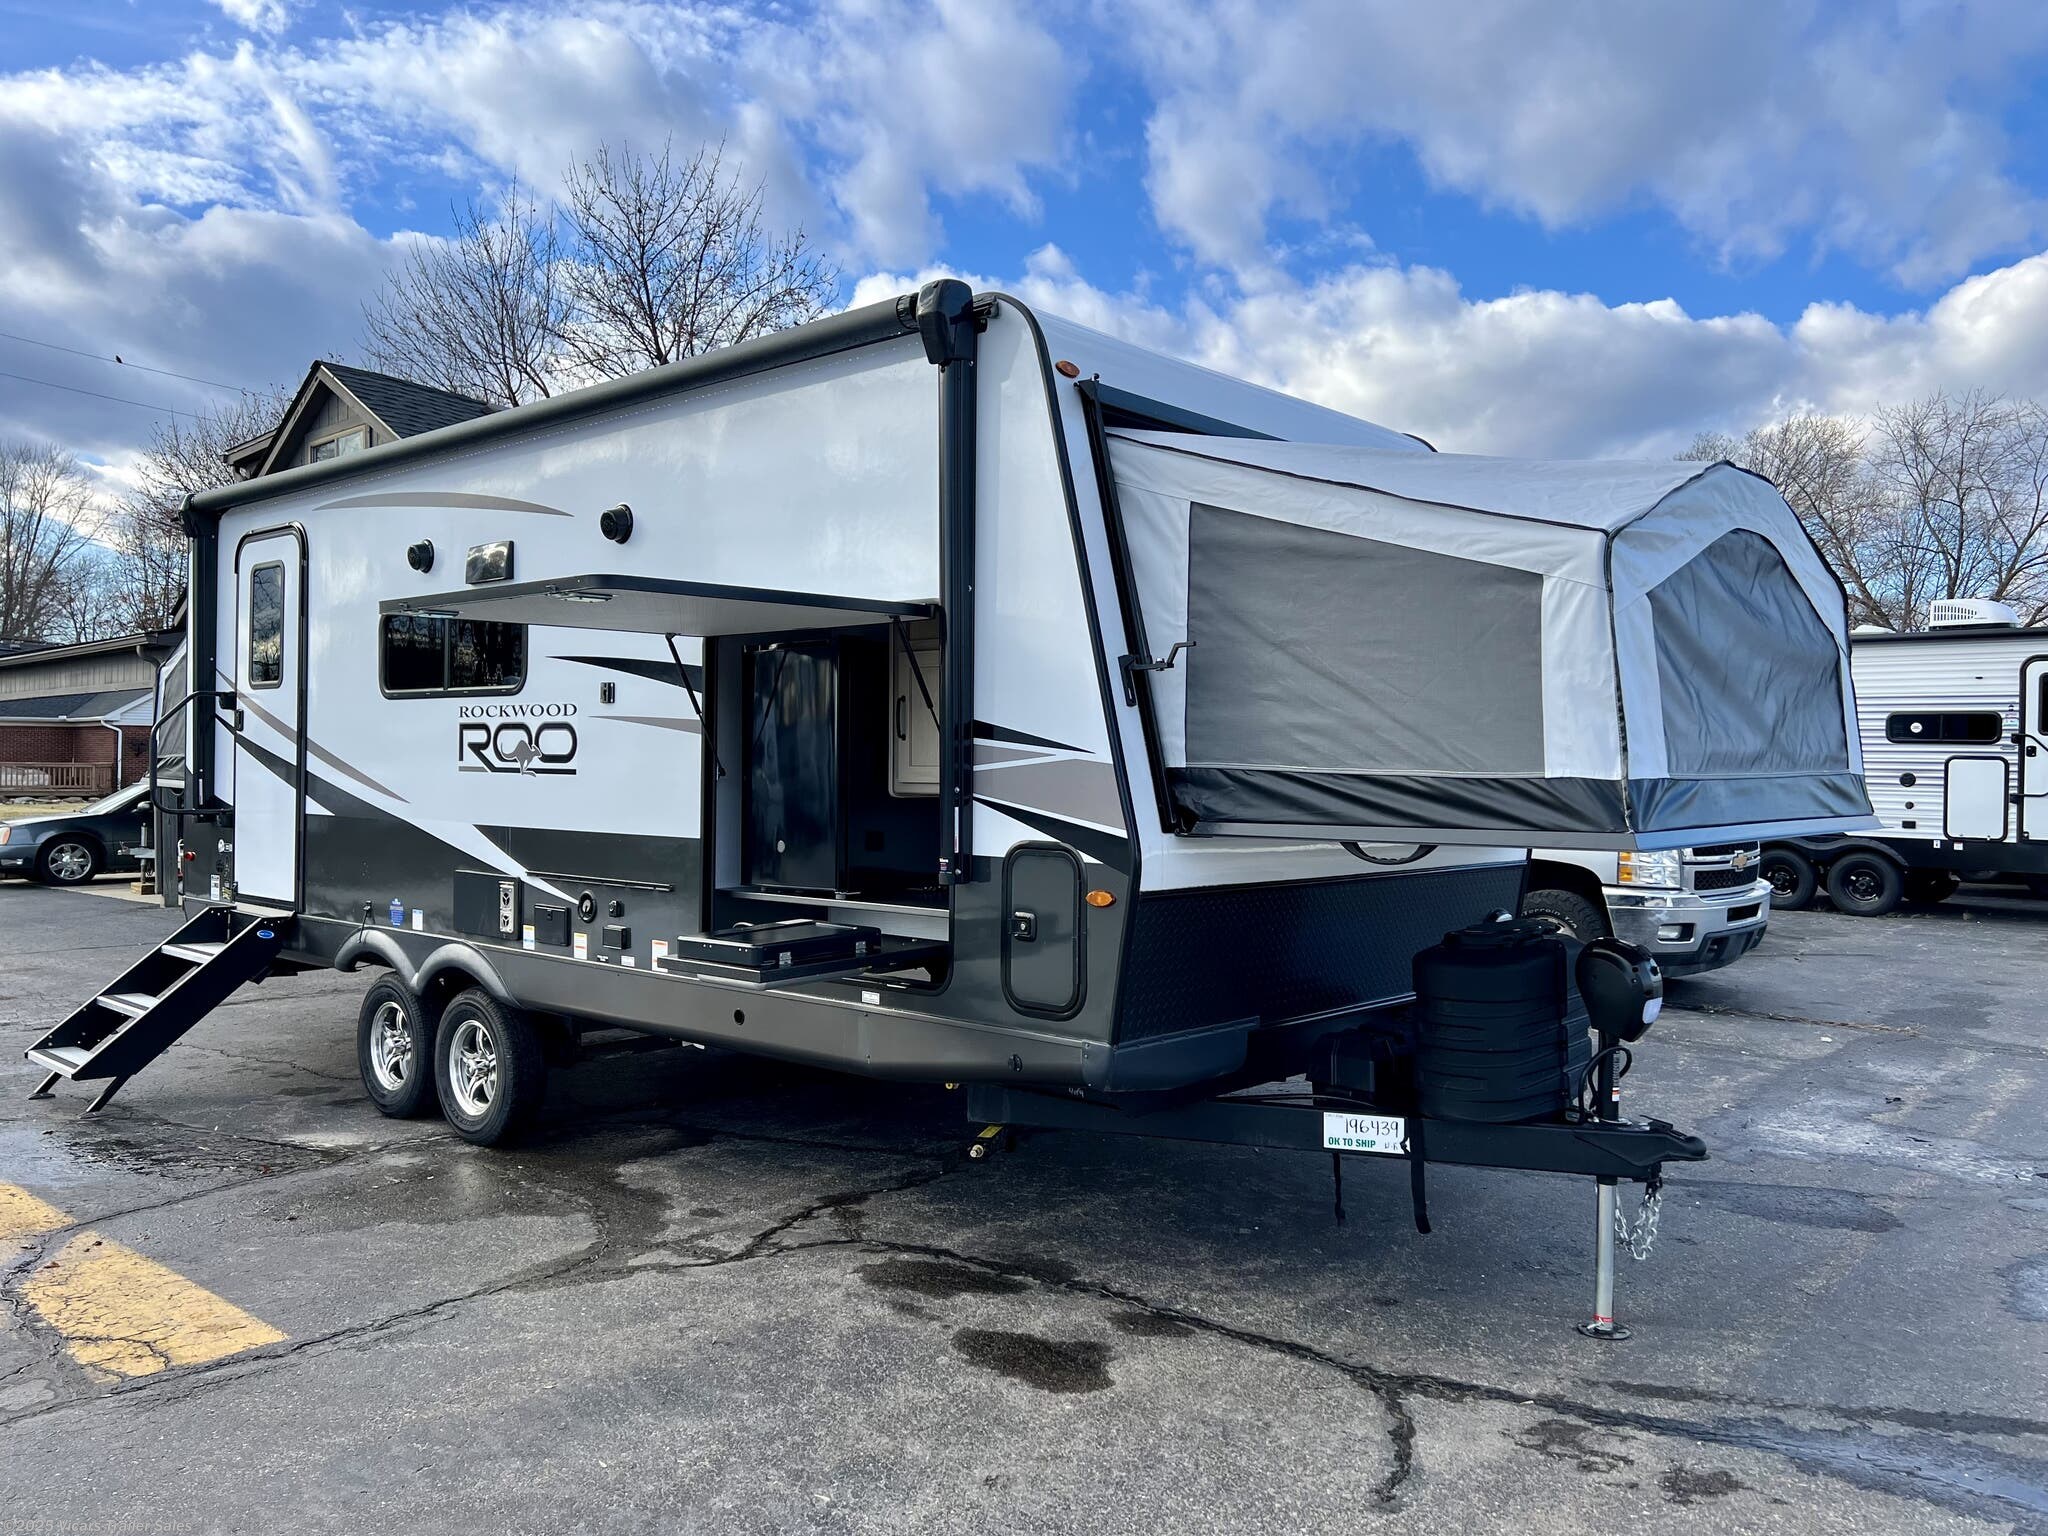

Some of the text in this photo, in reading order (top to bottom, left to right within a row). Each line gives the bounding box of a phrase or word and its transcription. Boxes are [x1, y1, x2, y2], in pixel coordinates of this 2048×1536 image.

[459, 703, 578, 718] ROCKWOOD
[459, 722, 578, 773] ROO
[1345, 1118, 1399, 1138] 196439
[1328, 1136, 1376, 1149] OK TO SHIP
